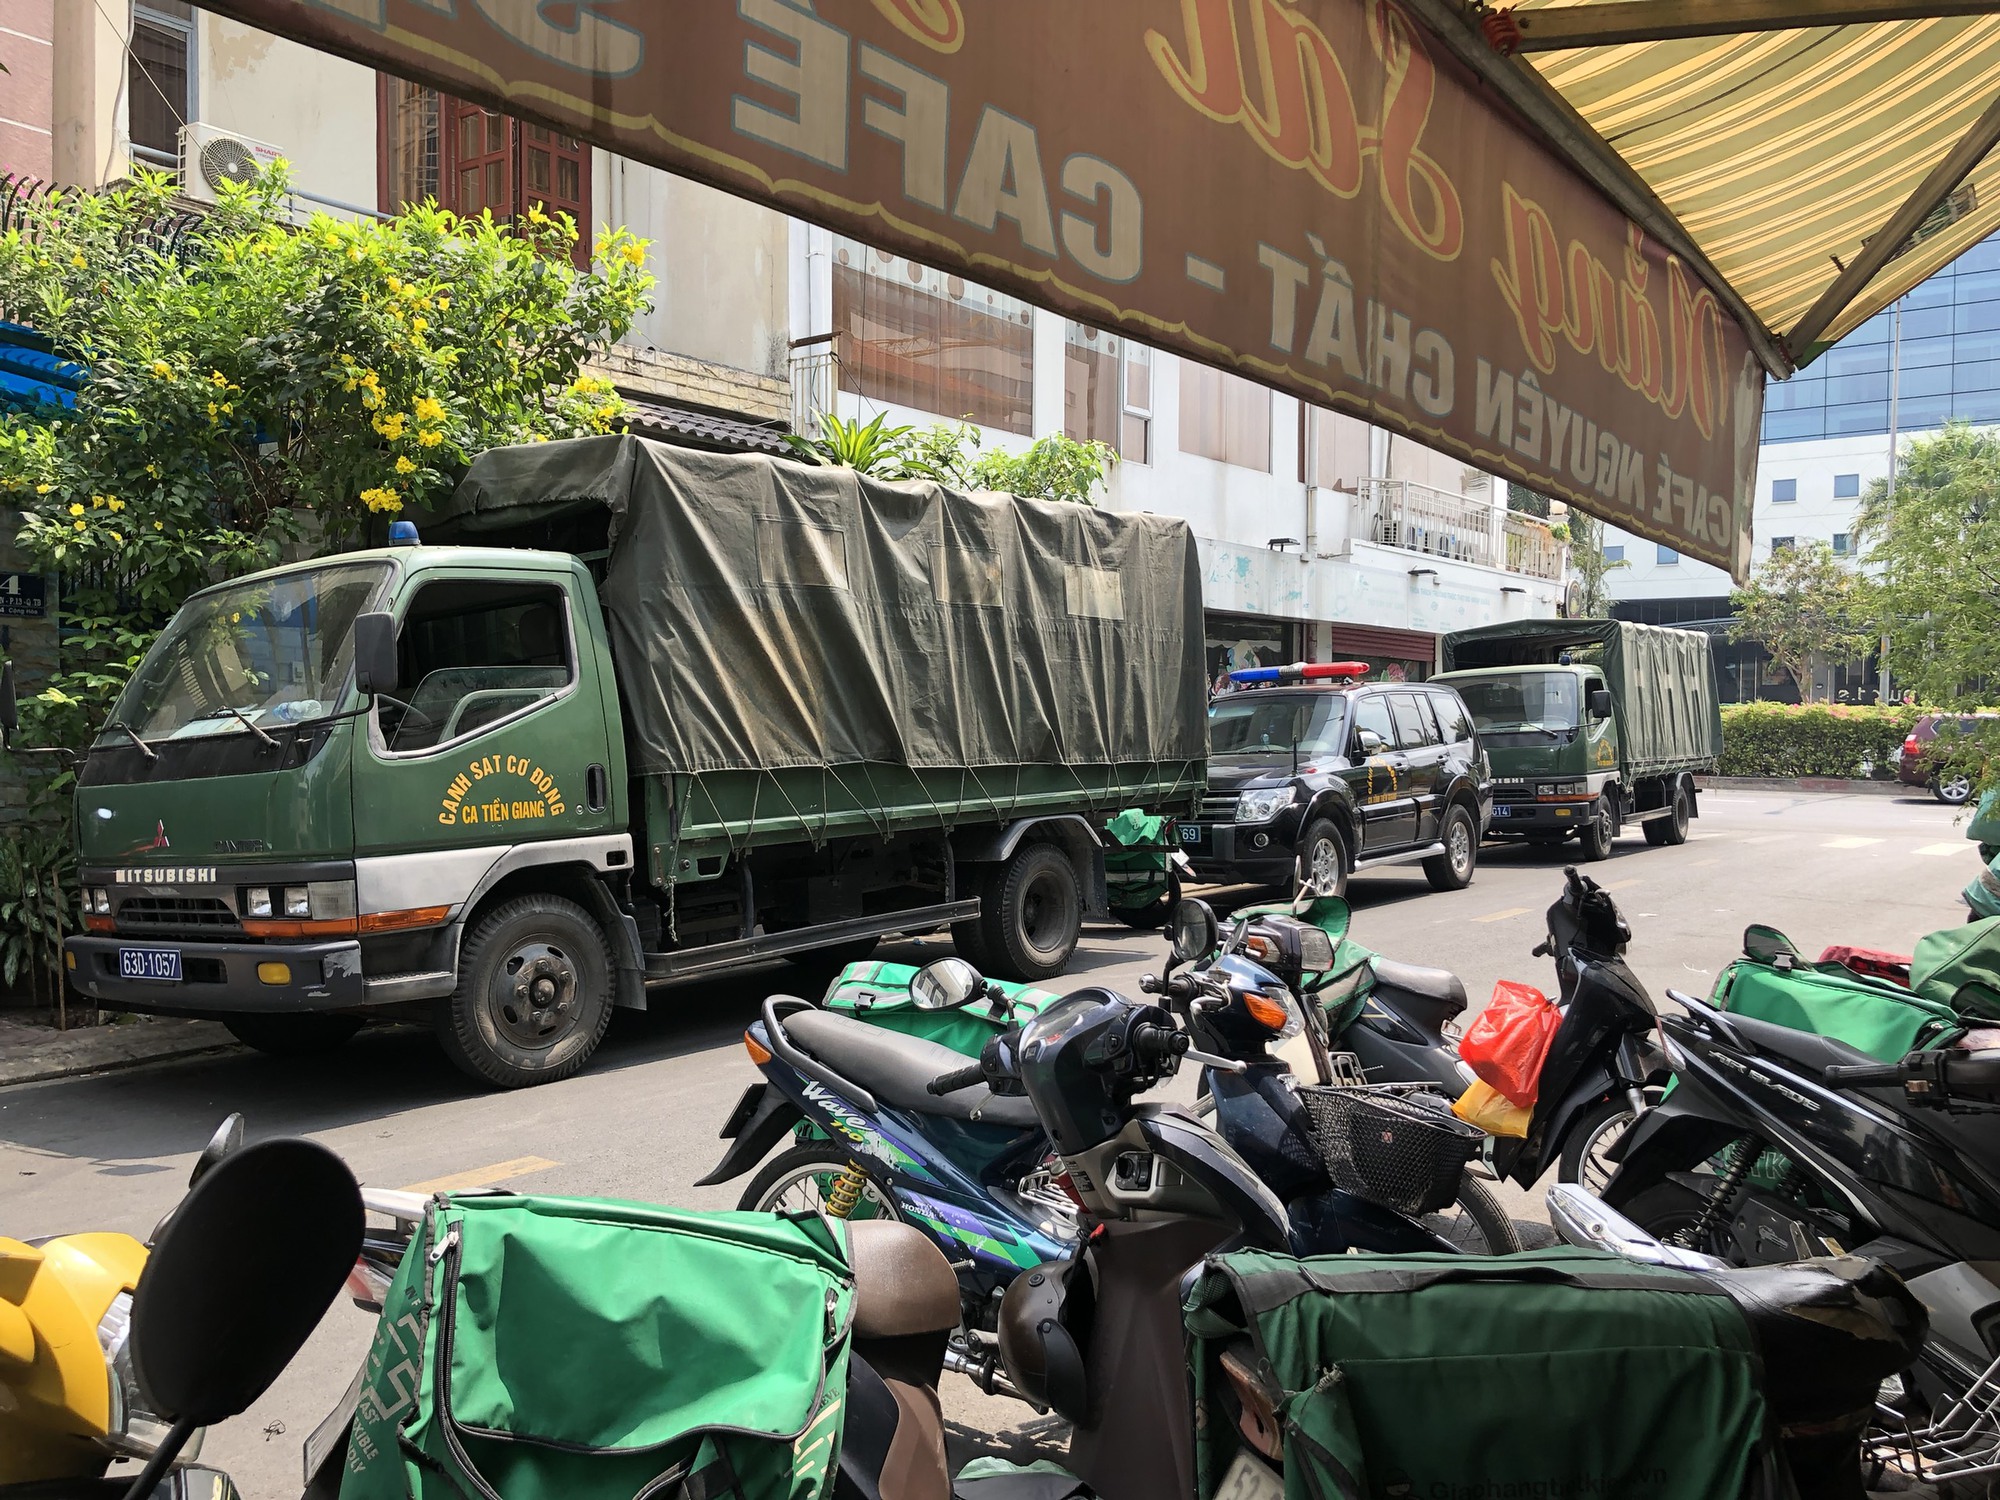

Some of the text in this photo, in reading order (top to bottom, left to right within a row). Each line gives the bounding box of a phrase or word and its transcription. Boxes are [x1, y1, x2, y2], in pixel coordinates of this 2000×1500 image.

[462, 797, 545, 824] CA TIỀN GIANG
[115, 867, 217, 883] MITSUBISHI
[802, 1080, 876, 1132] Wave
[901, 1201, 936, 1220] HONDA
